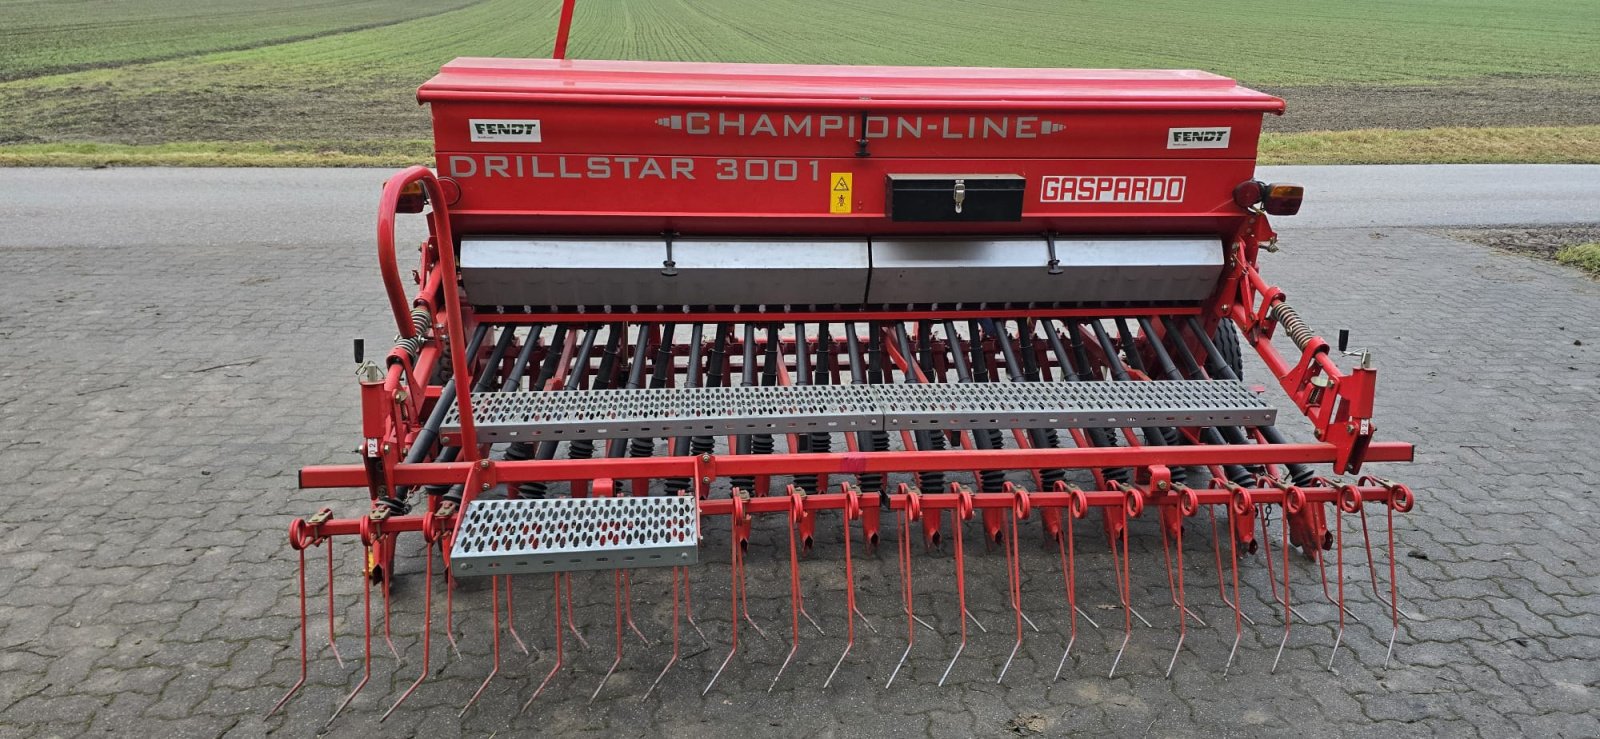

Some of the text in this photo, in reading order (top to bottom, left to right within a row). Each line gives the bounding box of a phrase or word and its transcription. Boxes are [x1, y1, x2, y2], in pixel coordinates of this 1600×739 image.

[474, 123, 536, 135] FENDT
[686, 111, 1038, 139] CHAMPION-LINE
[1173, 131, 1228, 142] FENDT
[449, 155, 819, 181] DRILLSTAR 3001
[1042, 176, 1185, 201] GASPARDO
